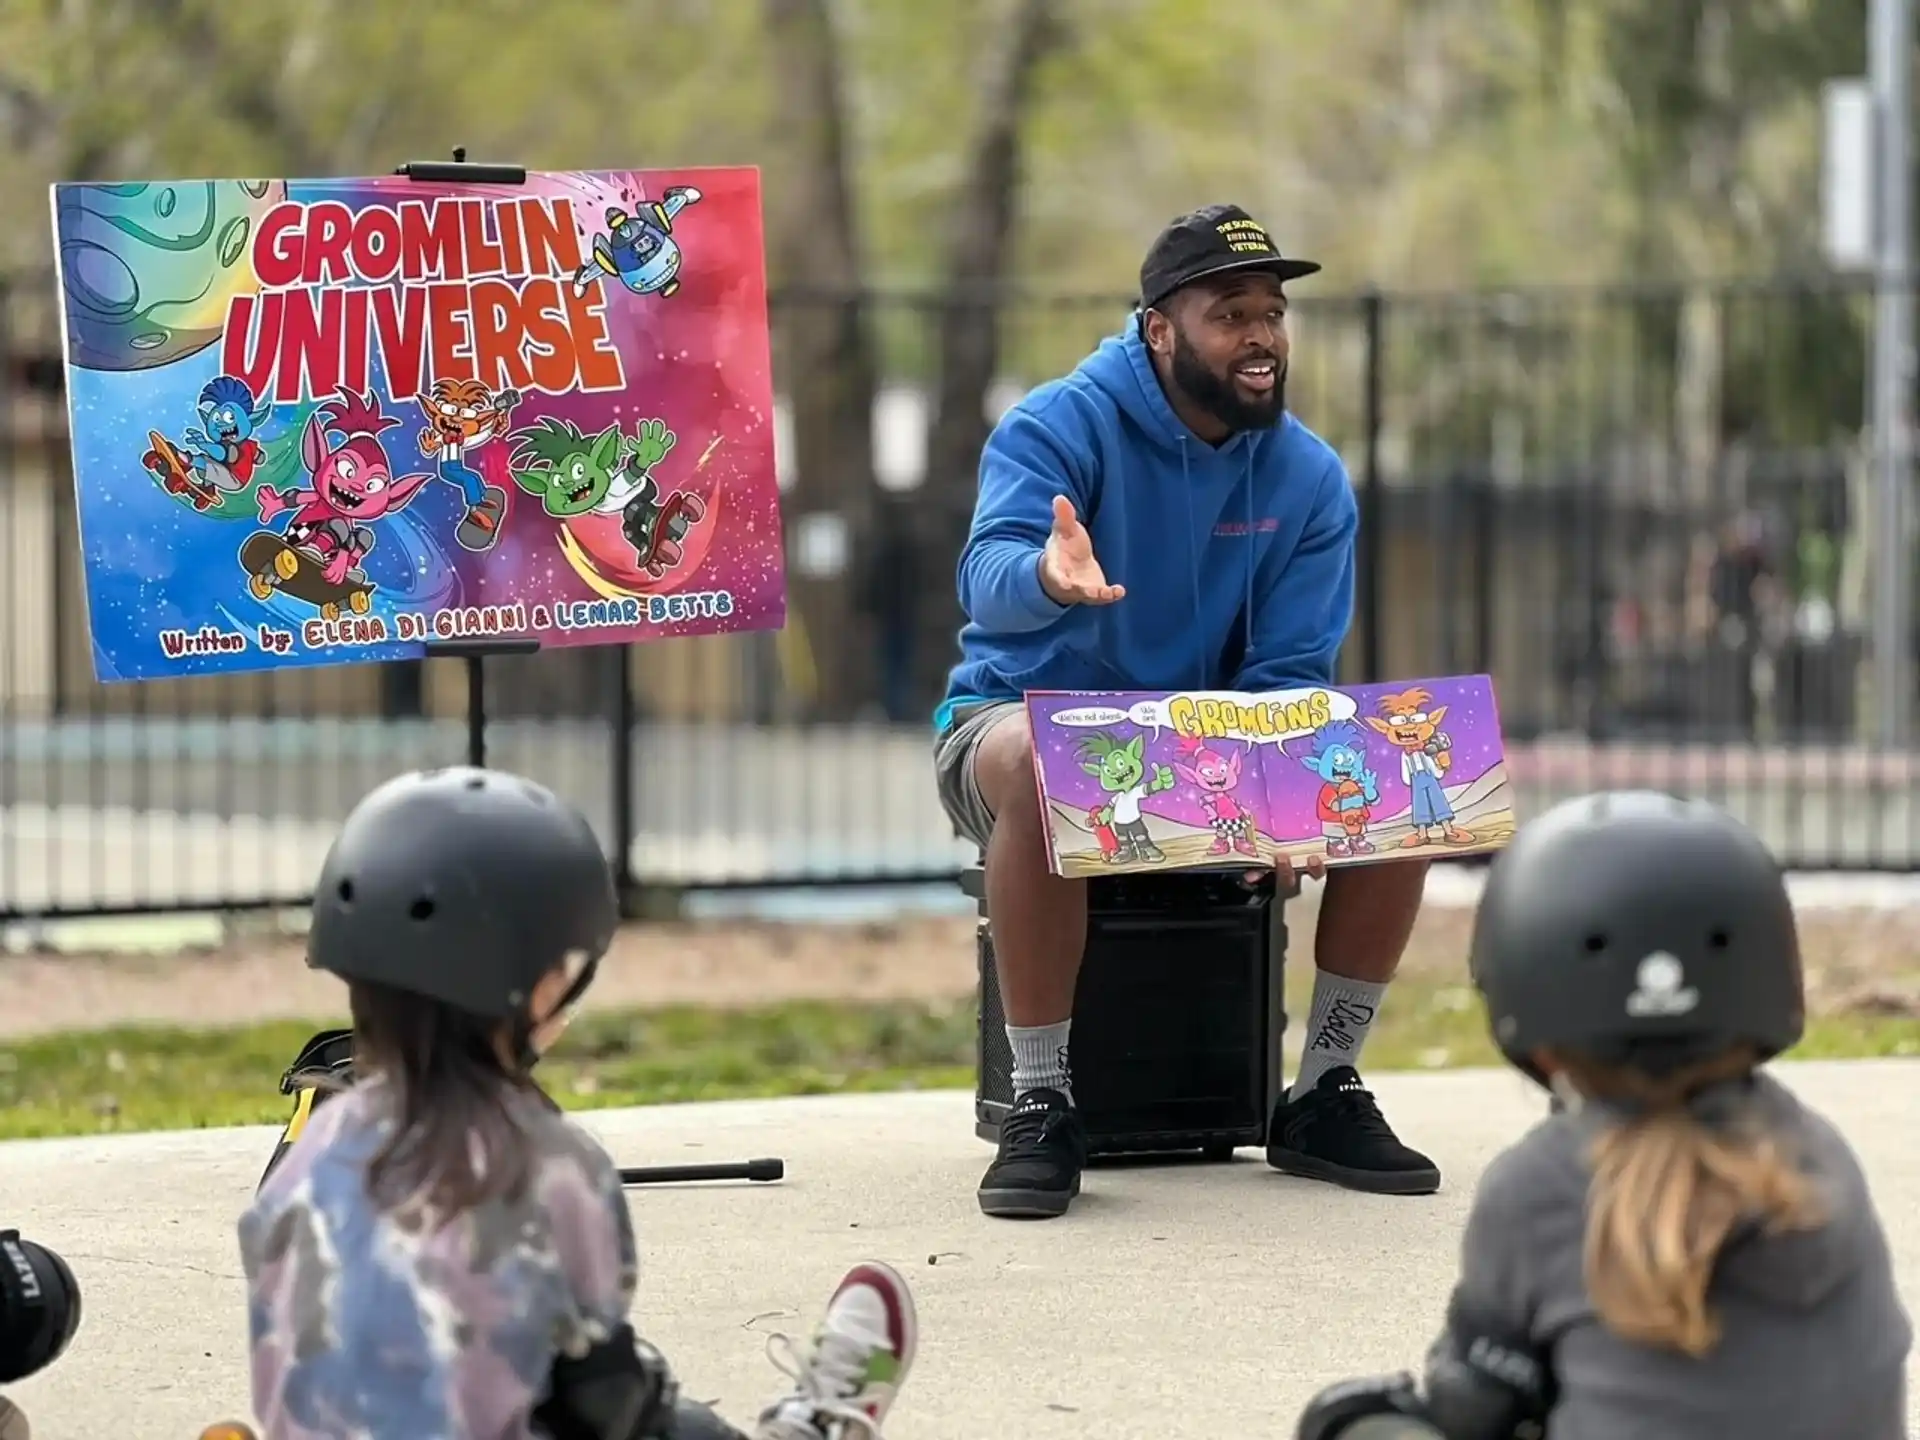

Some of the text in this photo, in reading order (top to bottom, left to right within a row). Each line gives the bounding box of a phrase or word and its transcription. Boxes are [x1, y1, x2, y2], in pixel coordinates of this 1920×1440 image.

[250, 197, 584, 288] GROMLIN
[222, 277, 626, 404] UNIVERSE
[160, 626, 245, 657] Written
[302, 619, 386, 649] ELENA
[397, 614, 426, 638] DI
[434, 605, 527, 637] GIANNI
[533, 607, 549, 628] &
[555, 597, 639, 627] LEMAR
[650, 591, 733, 622] BETTS
